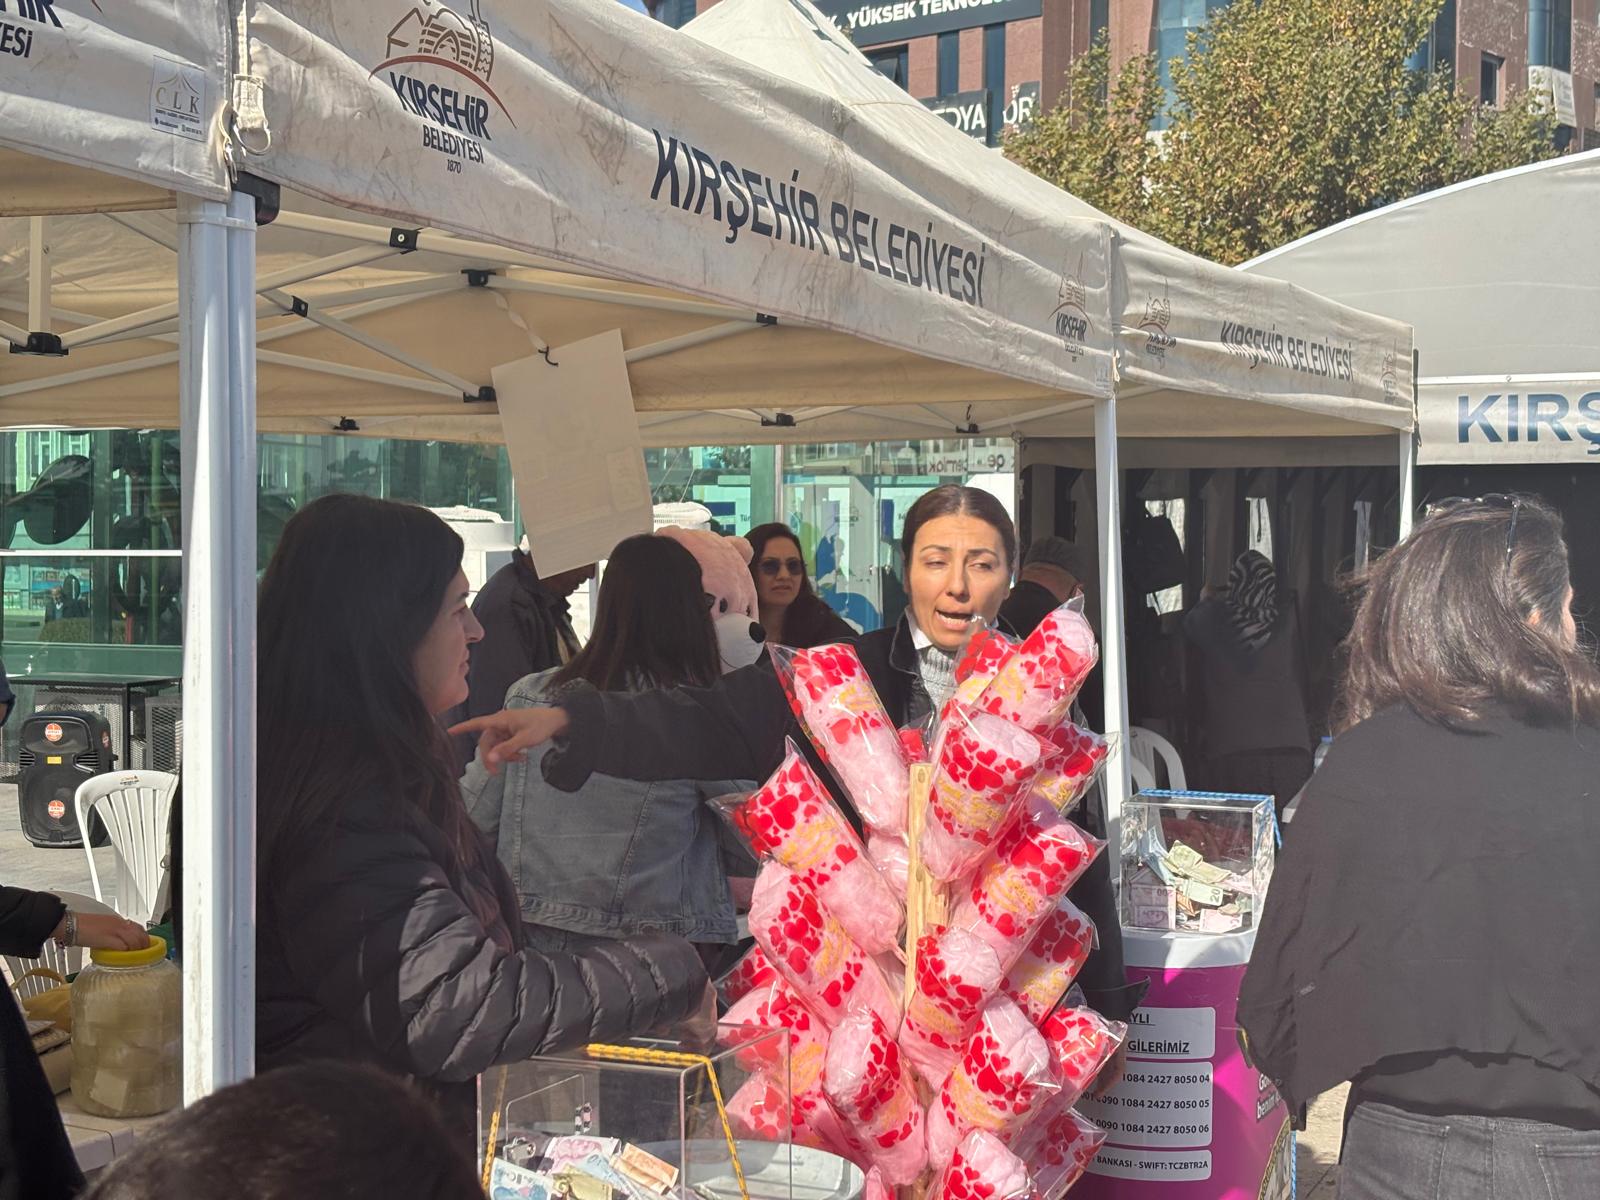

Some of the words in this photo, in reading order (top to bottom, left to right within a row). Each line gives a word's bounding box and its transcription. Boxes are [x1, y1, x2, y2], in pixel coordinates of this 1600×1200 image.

[847, 1, 917, 28] YÜKSEK
[0, 22, 33, 58] ESİ
[932, 103, 986, 131] DYA
[447, 159, 461, 174] 1870
[651, 128, 829, 256] KIRŞEHİR
[831, 201, 985, 308] BELEDİYESİ
[1220, 320, 1289, 369] KIRŞEHİR
[1287, 336, 1354, 382] BELEDİYESİ
[1128, 1013, 1150, 1024] YLI
[1122, 1073, 1145, 1083] 1084
[1147, 1074, 1171, 1084] 2427
[1174, 1075, 1198, 1084] 8050
[1199, 1074, 1210, 1083] 04
[1121, 1098, 1145, 1108] 1084
[1147, 1099, 1171, 1109] 2427
[1174, 1100, 1197, 1109] 8050
[1199, 1099, 1210, 1108] 05
[1121, 1123, 1144, 1133] 1084
[1146, 1125, 1171, 1134] 2427
[1173, 1125, 1197, 1134] 8050
[1198, 1124, 1209, 1133] 06
[1138, 1161, 1168, 1170] SWIFT:
[1169, 1160, 1208, 1170] TCZBTR2A
